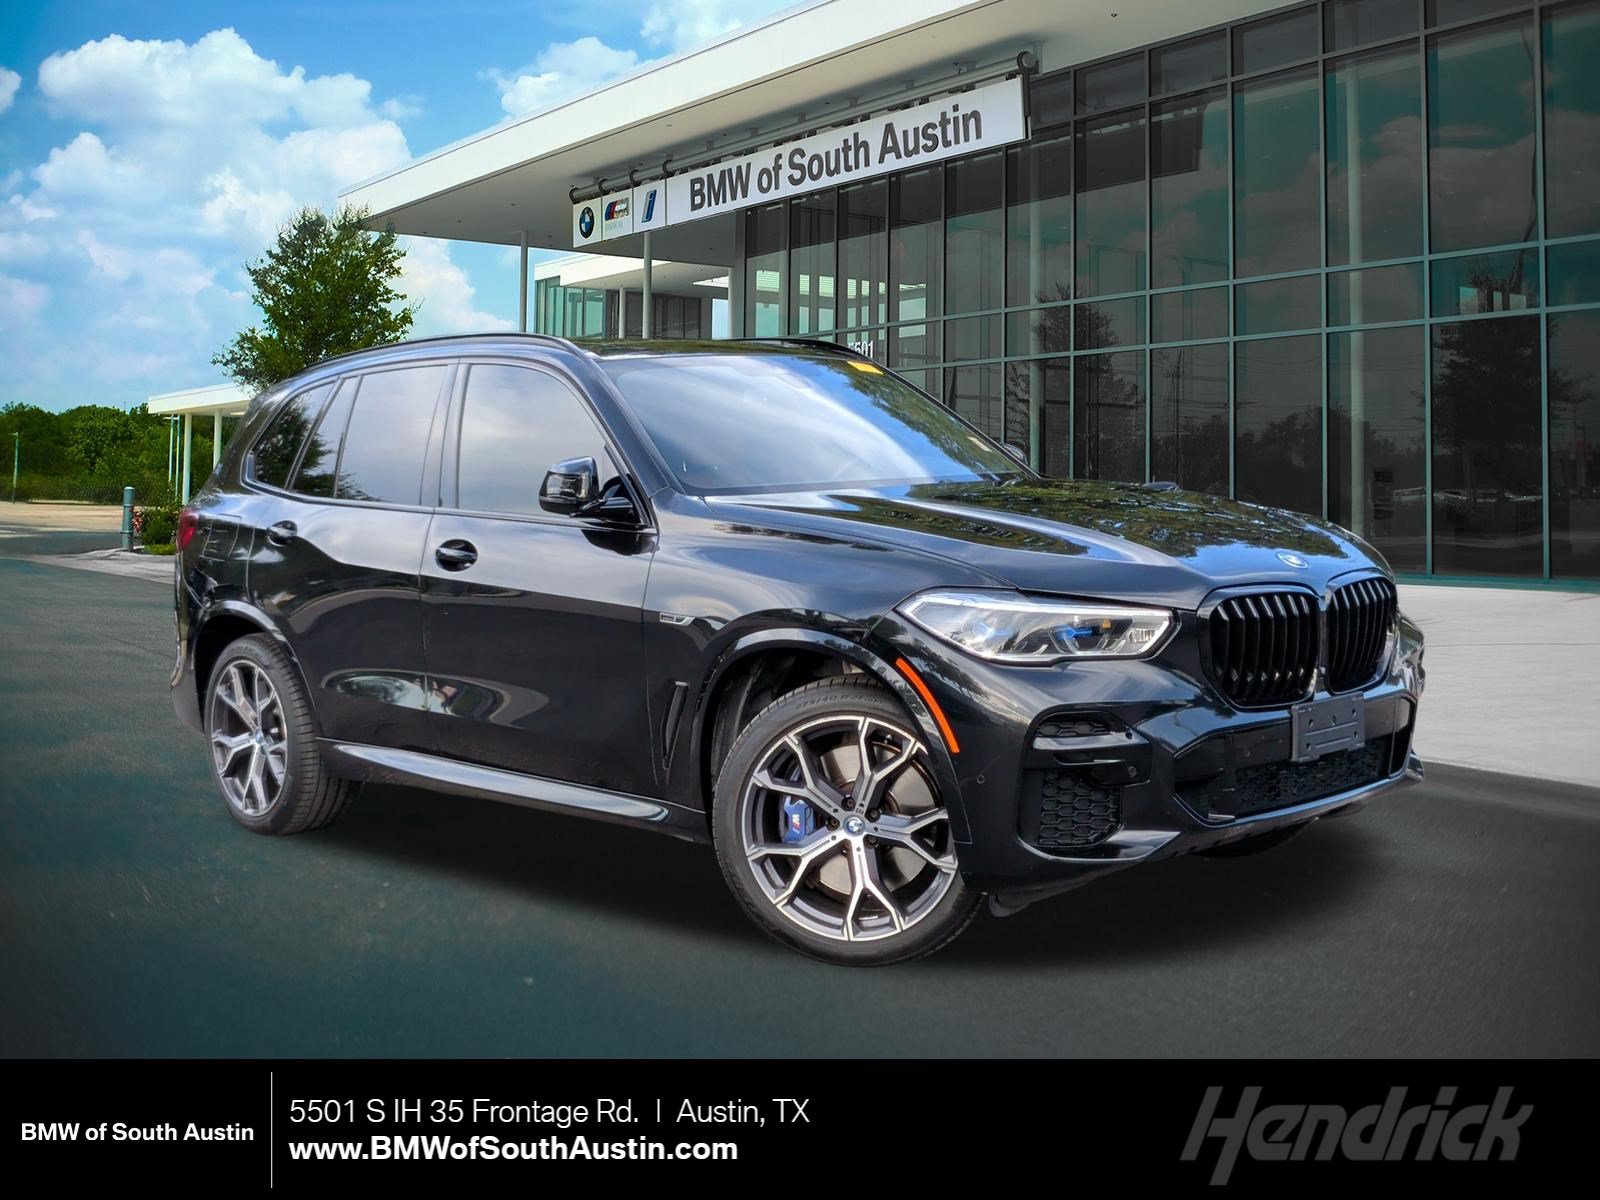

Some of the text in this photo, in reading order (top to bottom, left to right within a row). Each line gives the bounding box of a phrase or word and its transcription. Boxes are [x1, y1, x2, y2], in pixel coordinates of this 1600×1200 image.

[690, 103, 983, 212] BMW of South Austin
